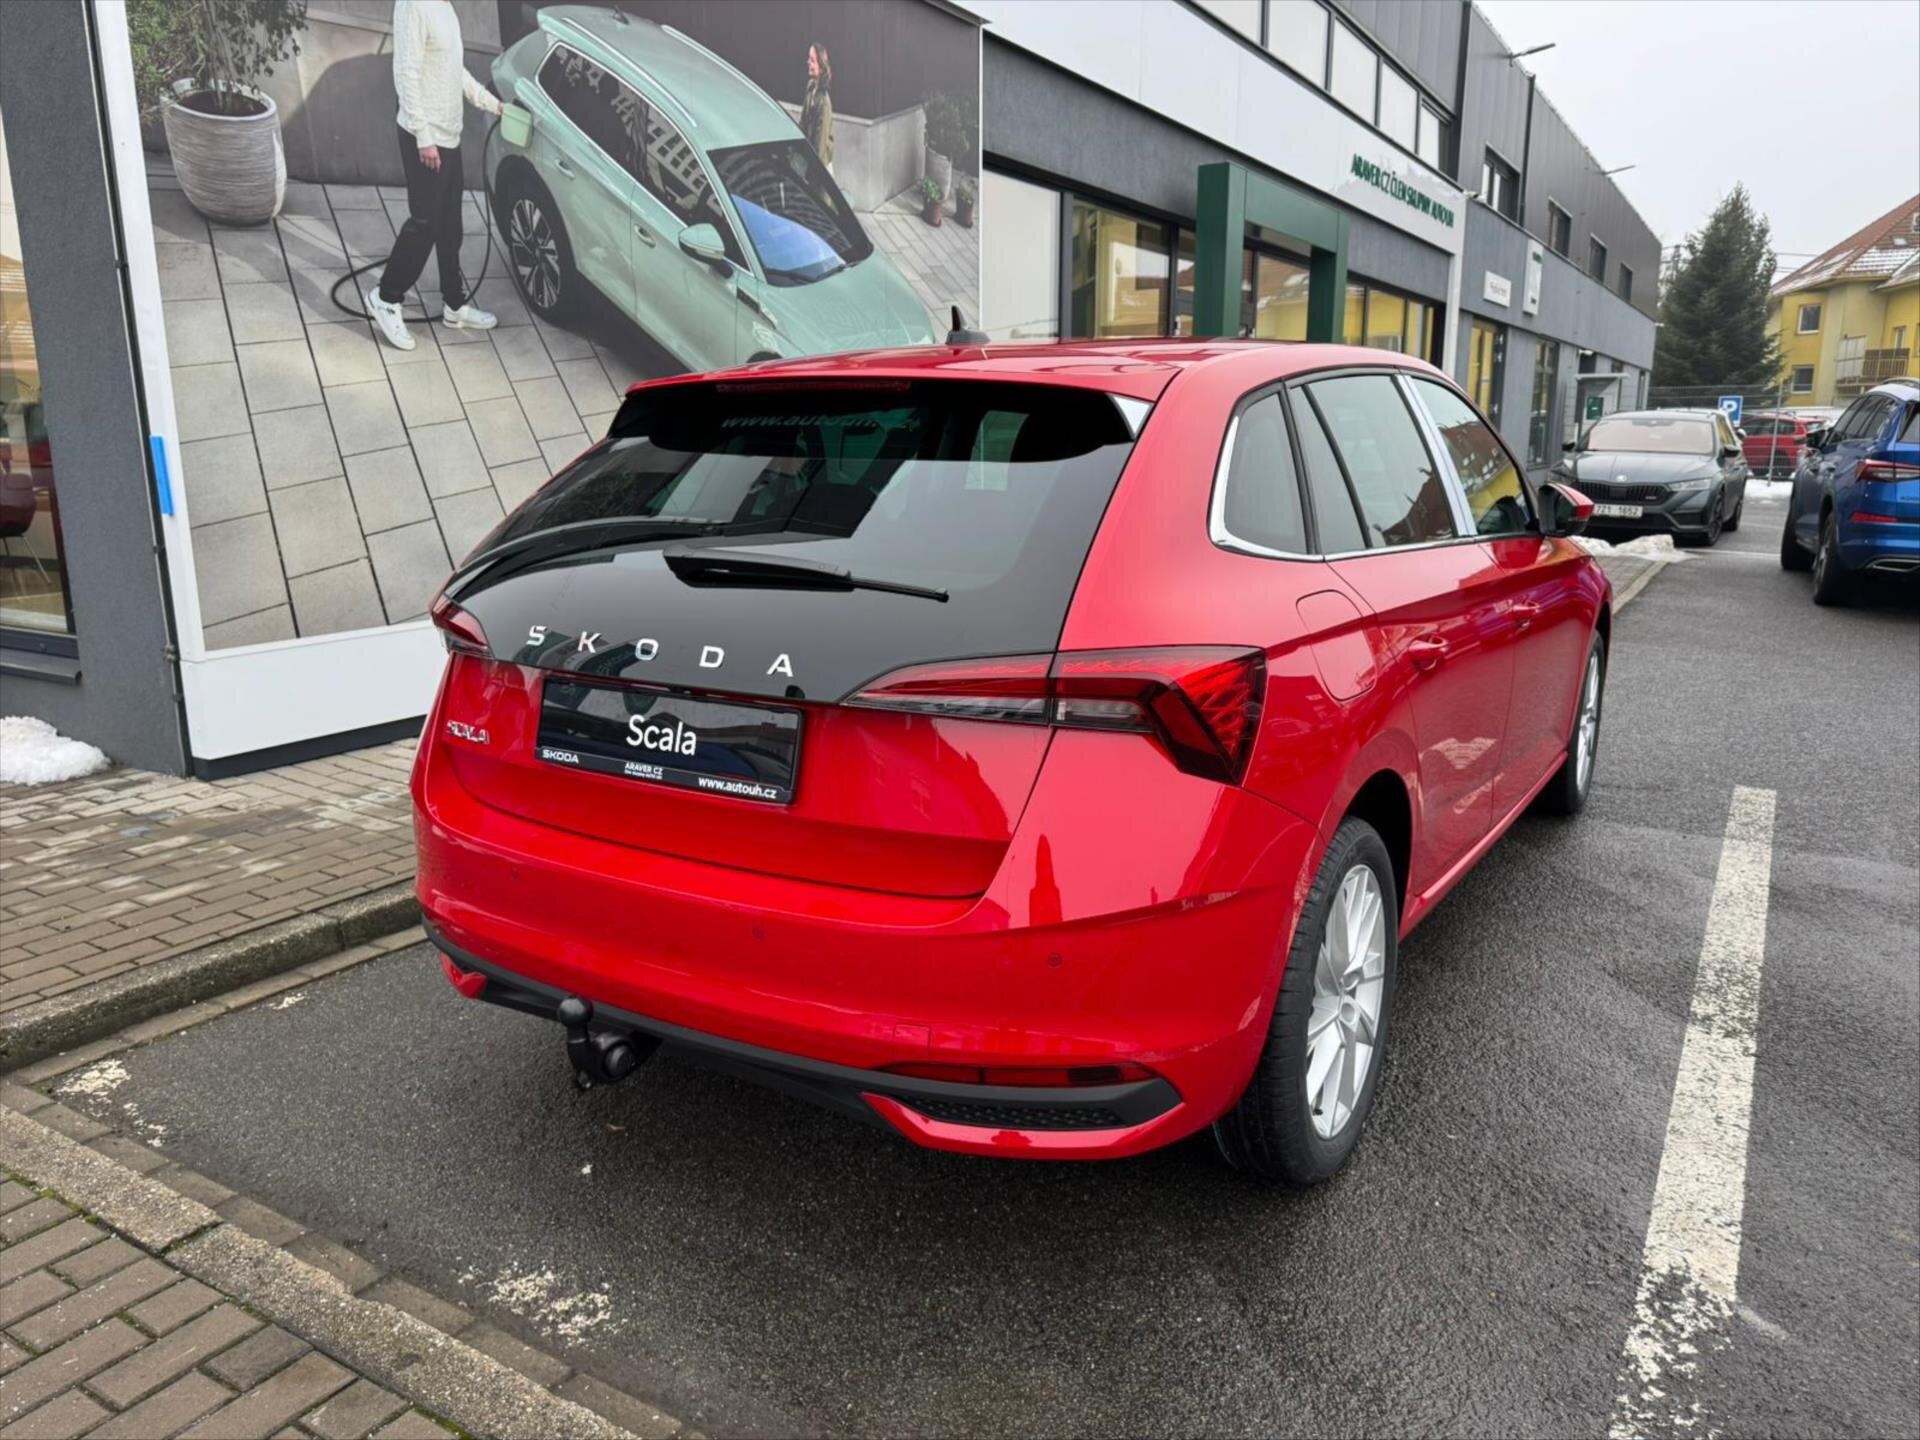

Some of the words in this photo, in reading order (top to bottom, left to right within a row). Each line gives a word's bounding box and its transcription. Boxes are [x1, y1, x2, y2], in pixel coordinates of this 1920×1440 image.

[1723, 400, 1738, 415] P
[626, 714, 697, 755] Scala
[625, 761, 652, 773] ARAVER
[653, 767, 663, 775] CZ
[698, 777, 777, 799] www.autouh.cz
